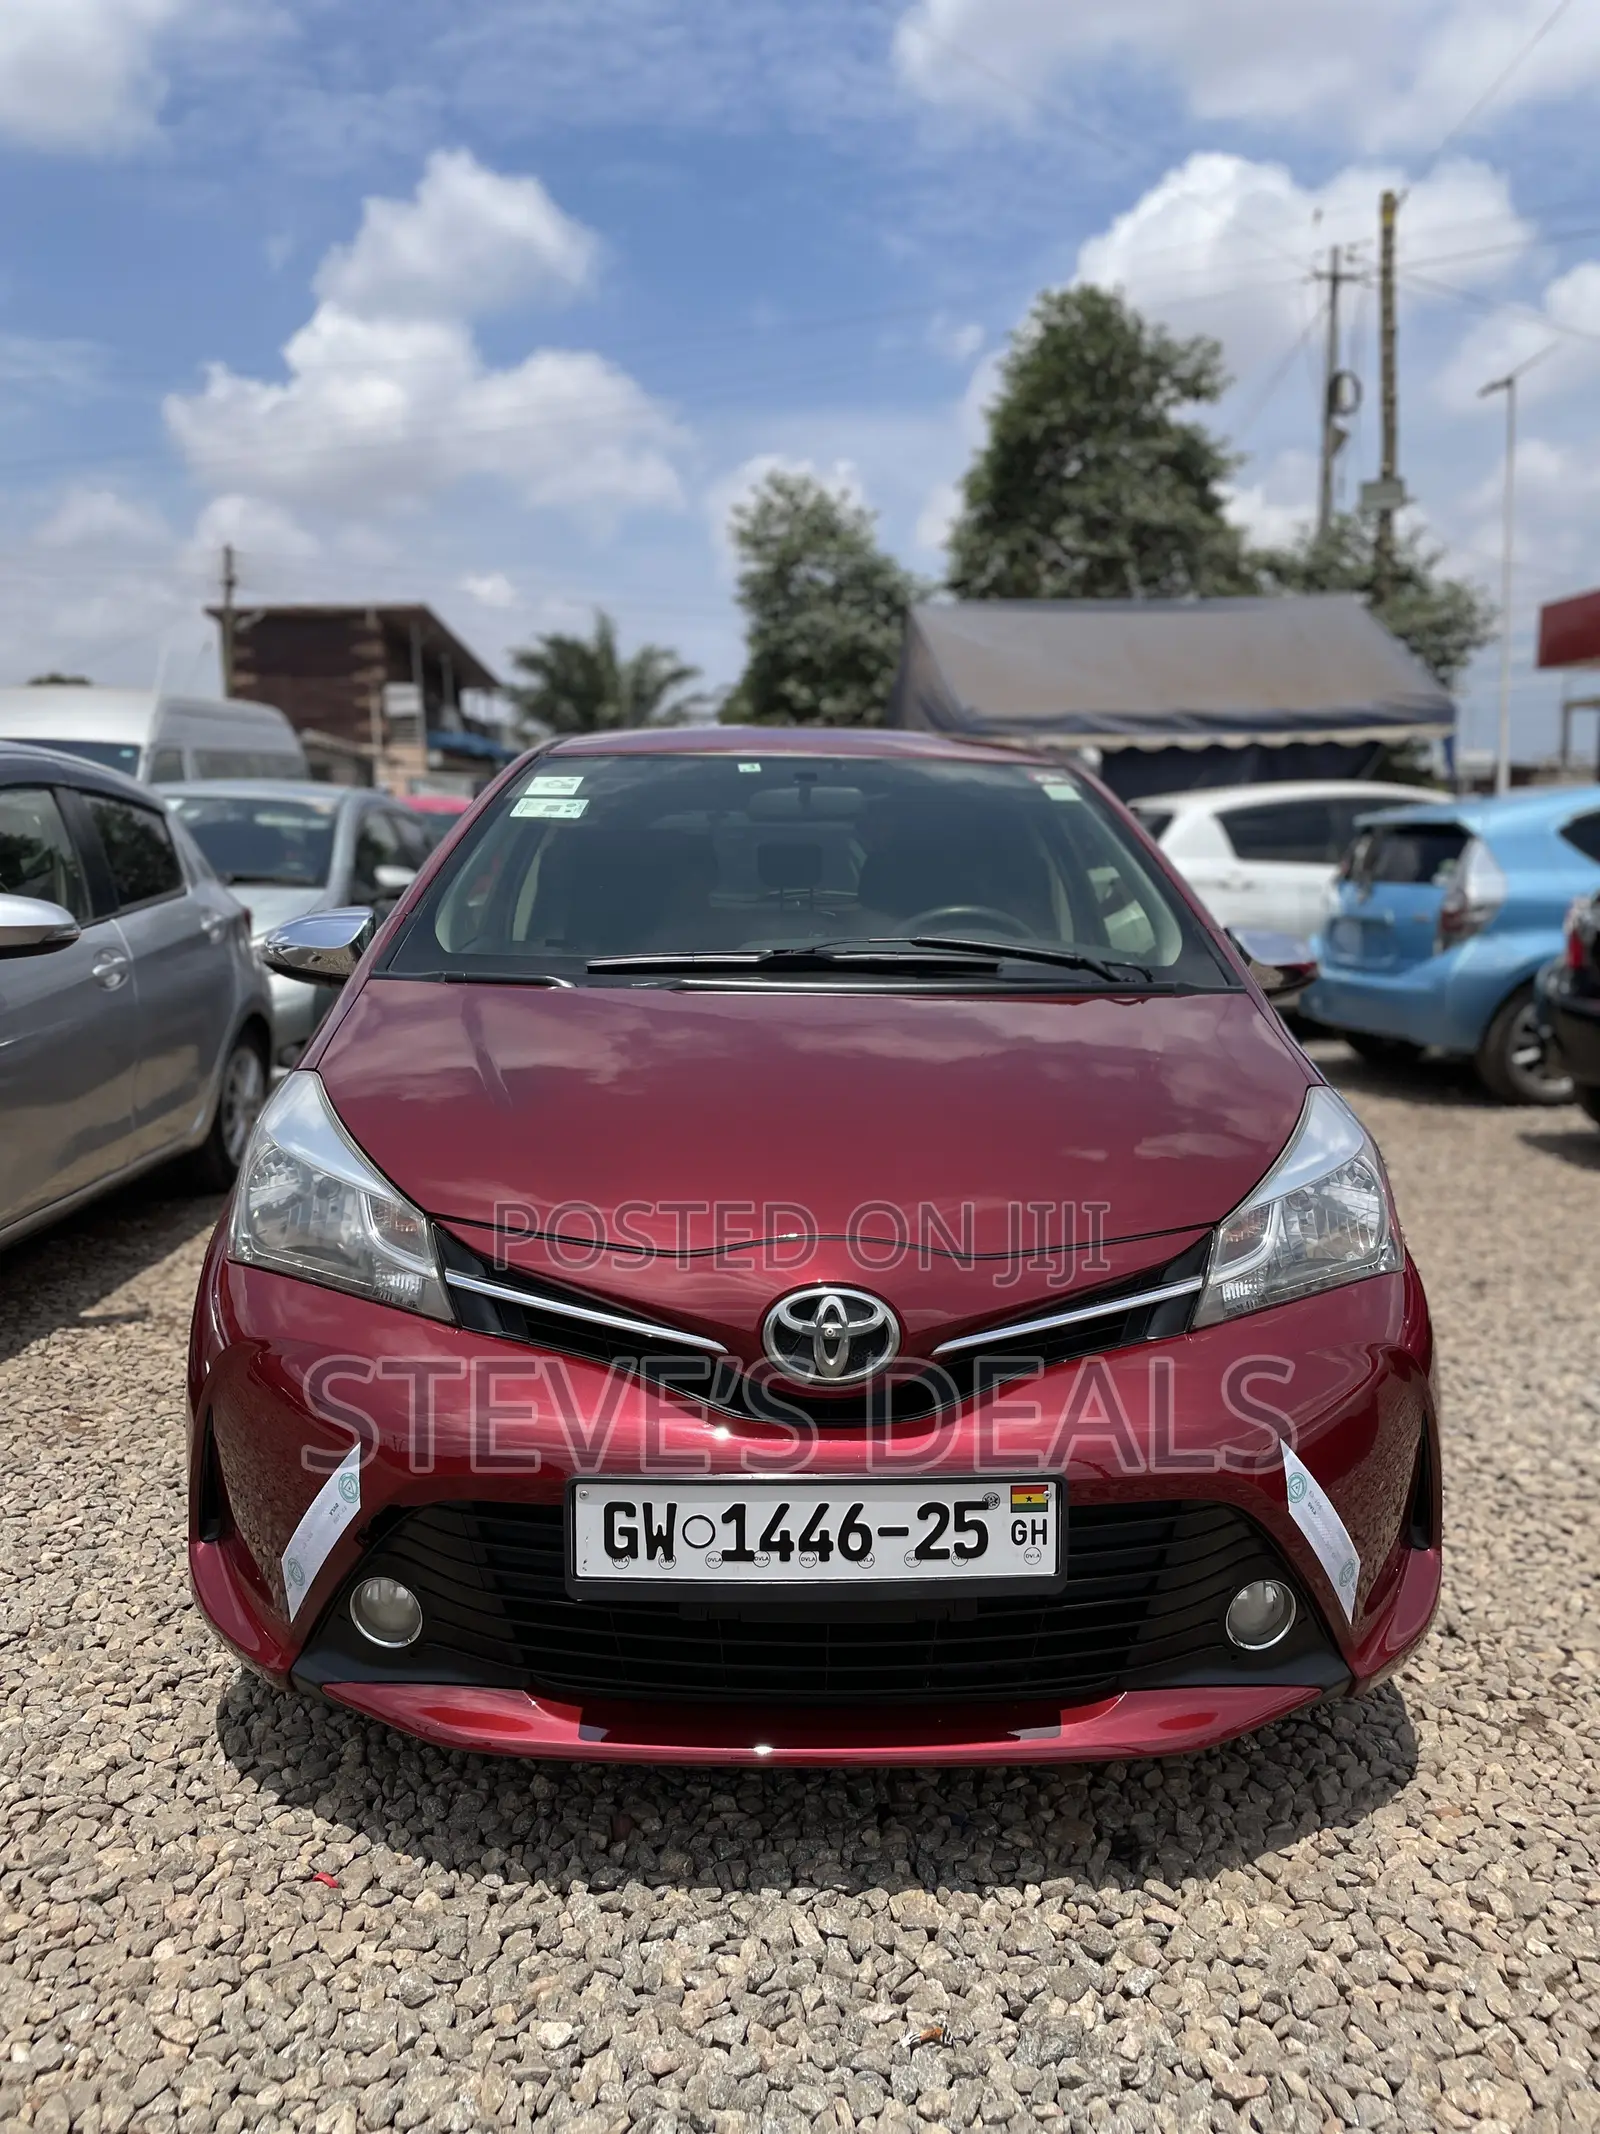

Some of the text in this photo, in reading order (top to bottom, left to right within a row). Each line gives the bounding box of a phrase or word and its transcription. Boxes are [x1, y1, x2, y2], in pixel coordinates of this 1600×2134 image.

[603, 1500, 989, 1562] GW 1446-25
[1011, 1518, 1048, 1546] GH
